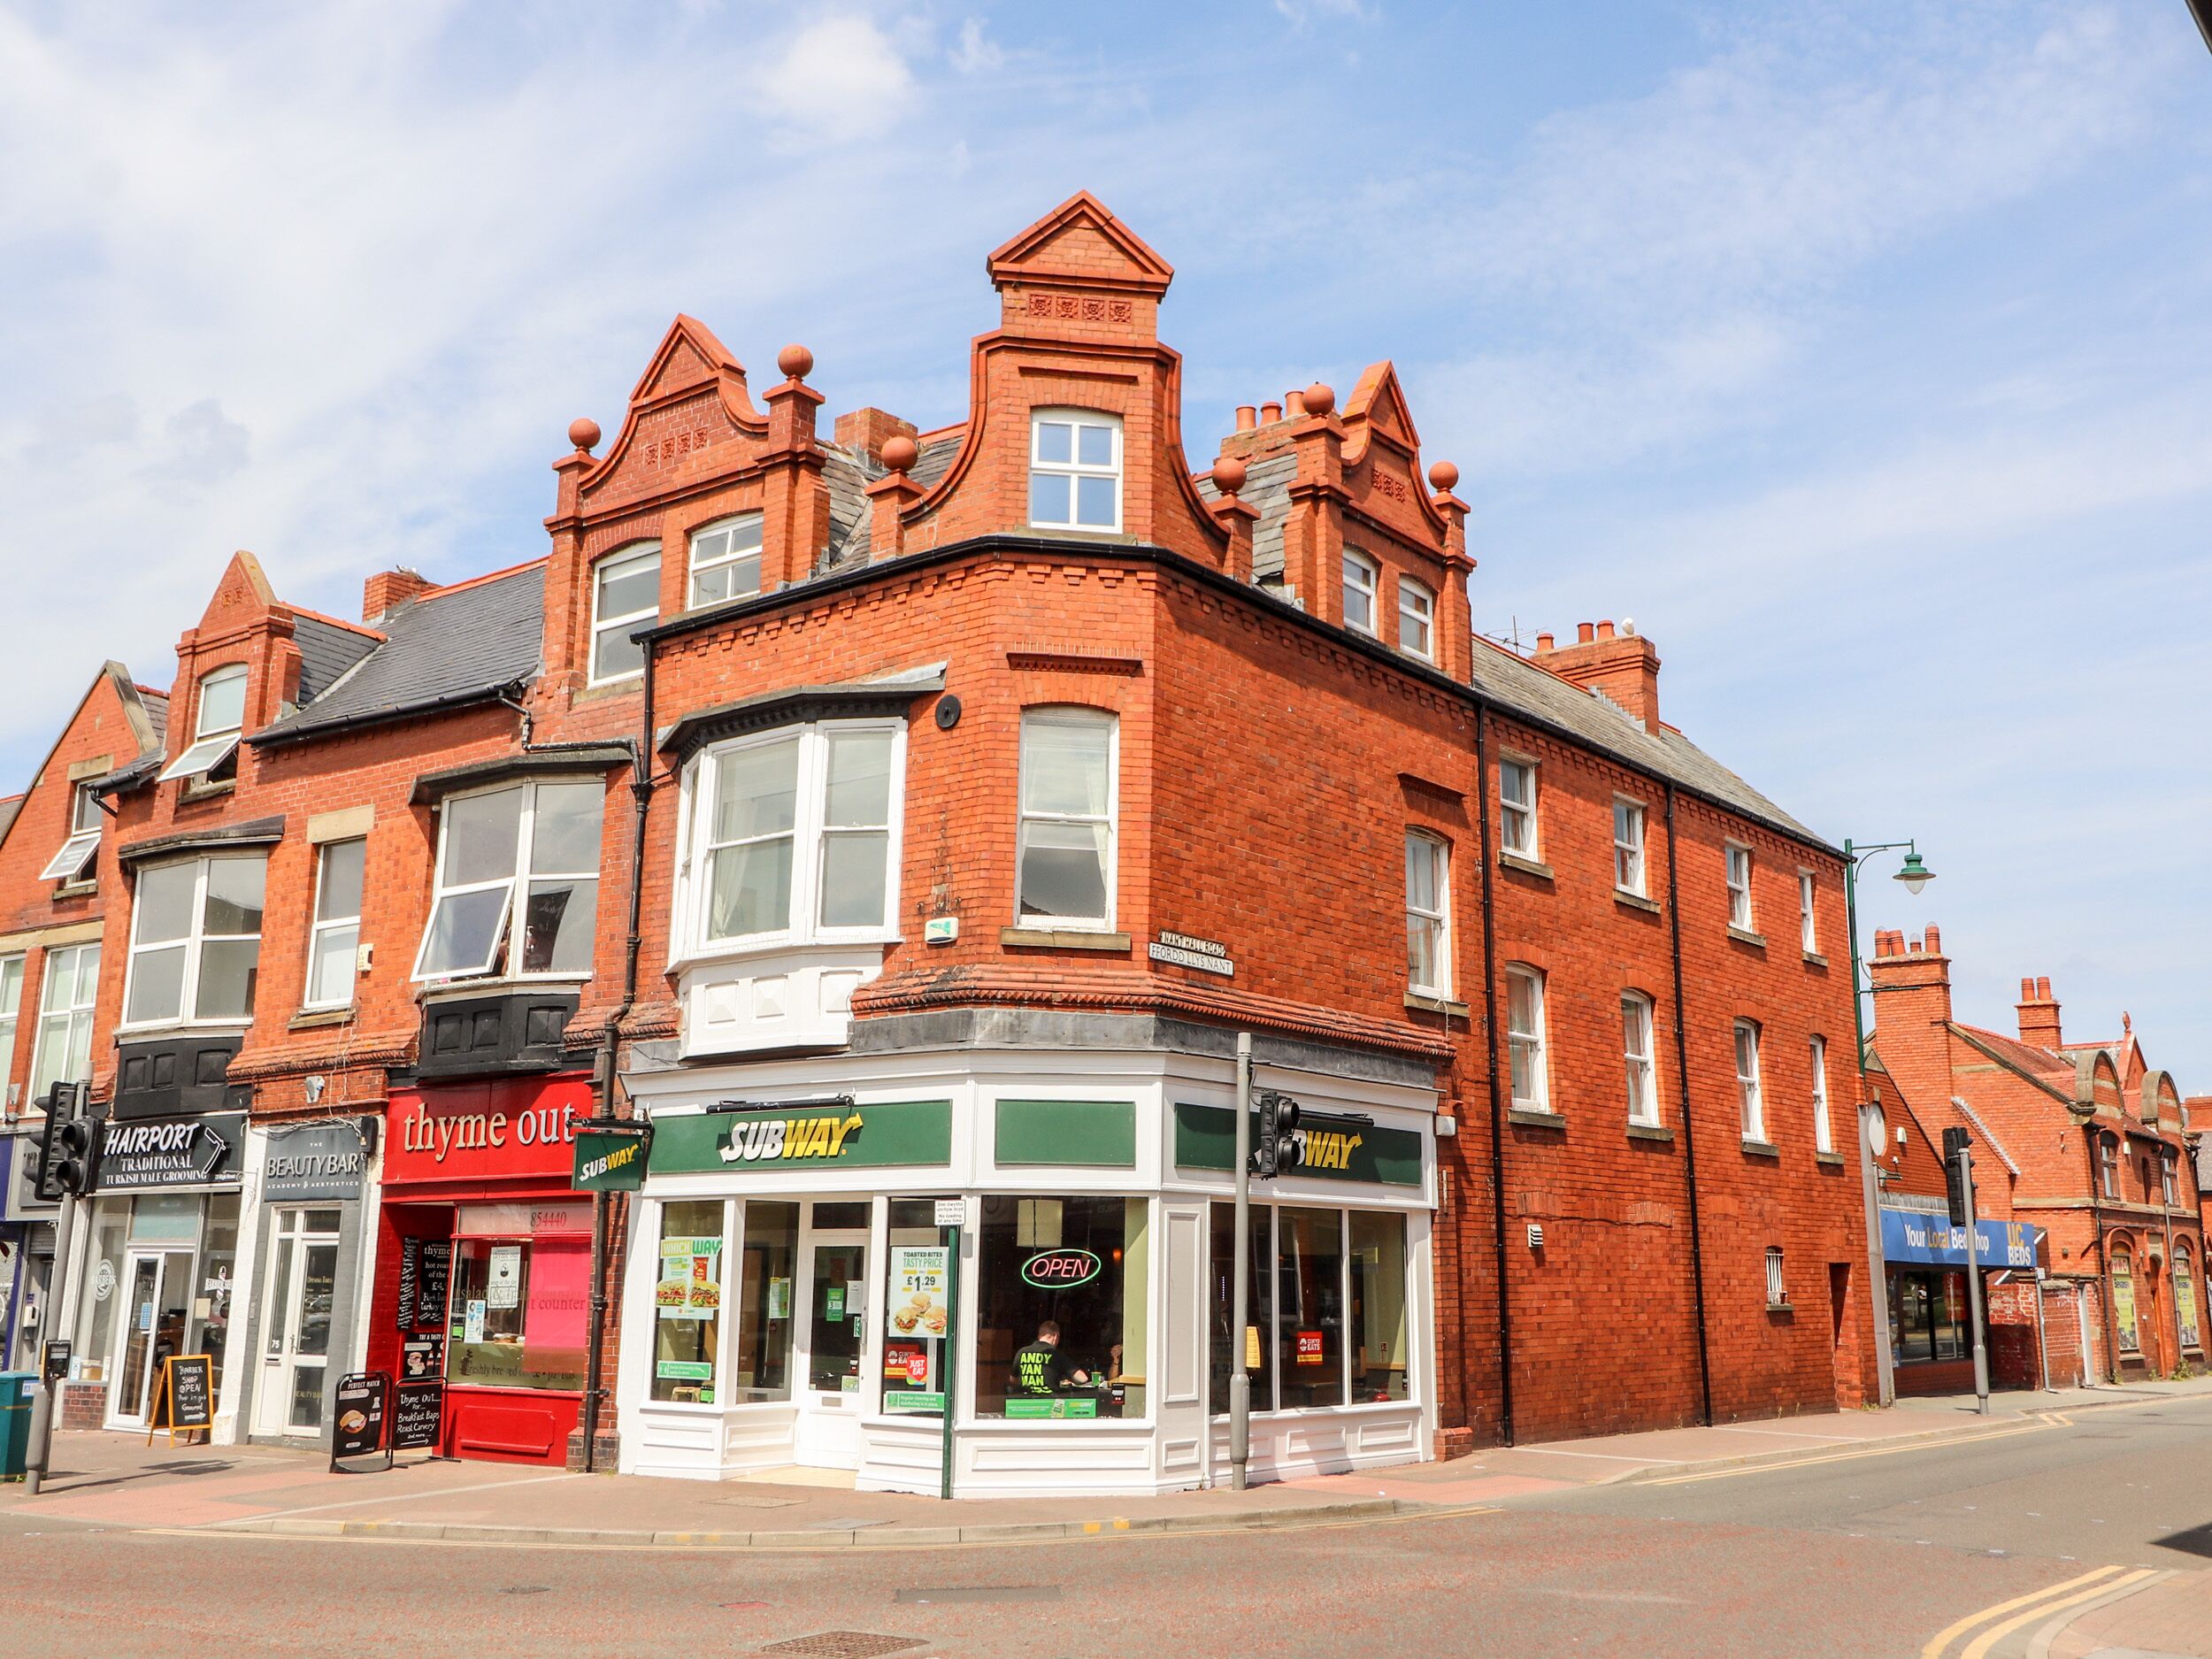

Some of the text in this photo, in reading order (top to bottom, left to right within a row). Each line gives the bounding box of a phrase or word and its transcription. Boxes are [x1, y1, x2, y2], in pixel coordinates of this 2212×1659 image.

[1162, 931, 1222, 956] NANT HALL ROAD
[1152, 945, 1230, 973] FFORDD LLYS NANT
[104, 1122, 200, 1156] HAIRPORT
[403, 1102, 575, 1161] thyme out
[718, 1111, 864, 1163] SUBWAY
[120, 1154, 193, 1172] TRADITIONAL
[266, 1152, 358, 1178] BEAUTY BAR
[580, 1142, 639, 1181] SUBWAY
[106, 1172, 138, 1186] TURKISH
[140, 1172, 161, 1183] MALE
[163, 1169, 207, 1181] GROOMING
[531, 1211, 567, 1228] 854440
[1904, 1224, 1925, 1247] Your
[1926, 1226, 1949, 1249] Local
[1974, 1228, 1989, 1256] hop
[2006, 1223, 2025, 1247] UC
[424, 1245, 451, 1256] thyme
[664, 1240, 689, 1254] WHICH
[2008, 1245, 2031, 1265] BEDS
[903, 1258, 943, 1268] TASTY PRICE
[1032, 1258, 1090, 1278] OPEN
[271, 1340, 280, 1349] 75
[910, 1359, 925, 1370] JUST
[1020, 1352, 1053, 1364] ANDY
[179, 1365, 204, 1374] BARBER
[912, 1367, 925, 1376] EAT
[1020, 1363, 1042, 1376] VAN
[179, 1382, 202, 1394] OPEN
[1021, 1375, 1044, 1386] MAN
[397, 1410, 440, 1424] Breakfast Baps
[396, 1423, 436, 1433] Roast Carvery
